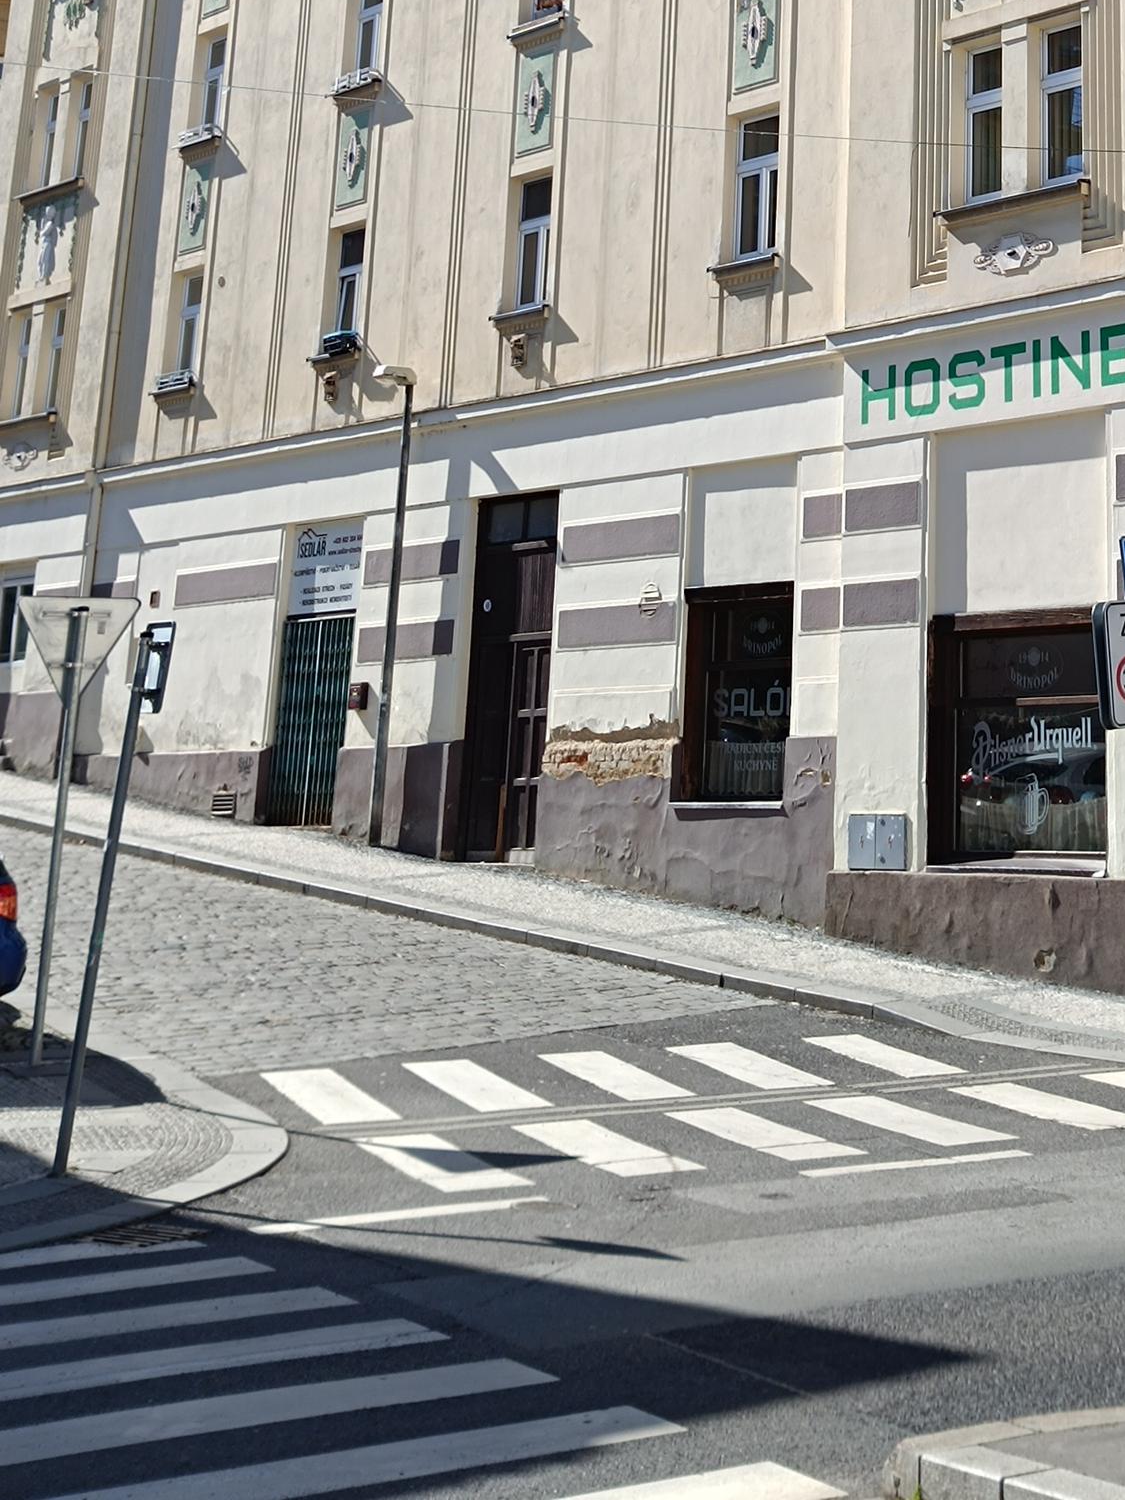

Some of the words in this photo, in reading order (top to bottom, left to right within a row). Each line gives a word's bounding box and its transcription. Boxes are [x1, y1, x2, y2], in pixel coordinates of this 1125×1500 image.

[1010, 666, 1059, 689] DRINOPOL
[713, 679, 790, 717] SALÓ
[971, 721, 1033, 779] Pilsner
[1031, 716, 1092, 765] Urquell
